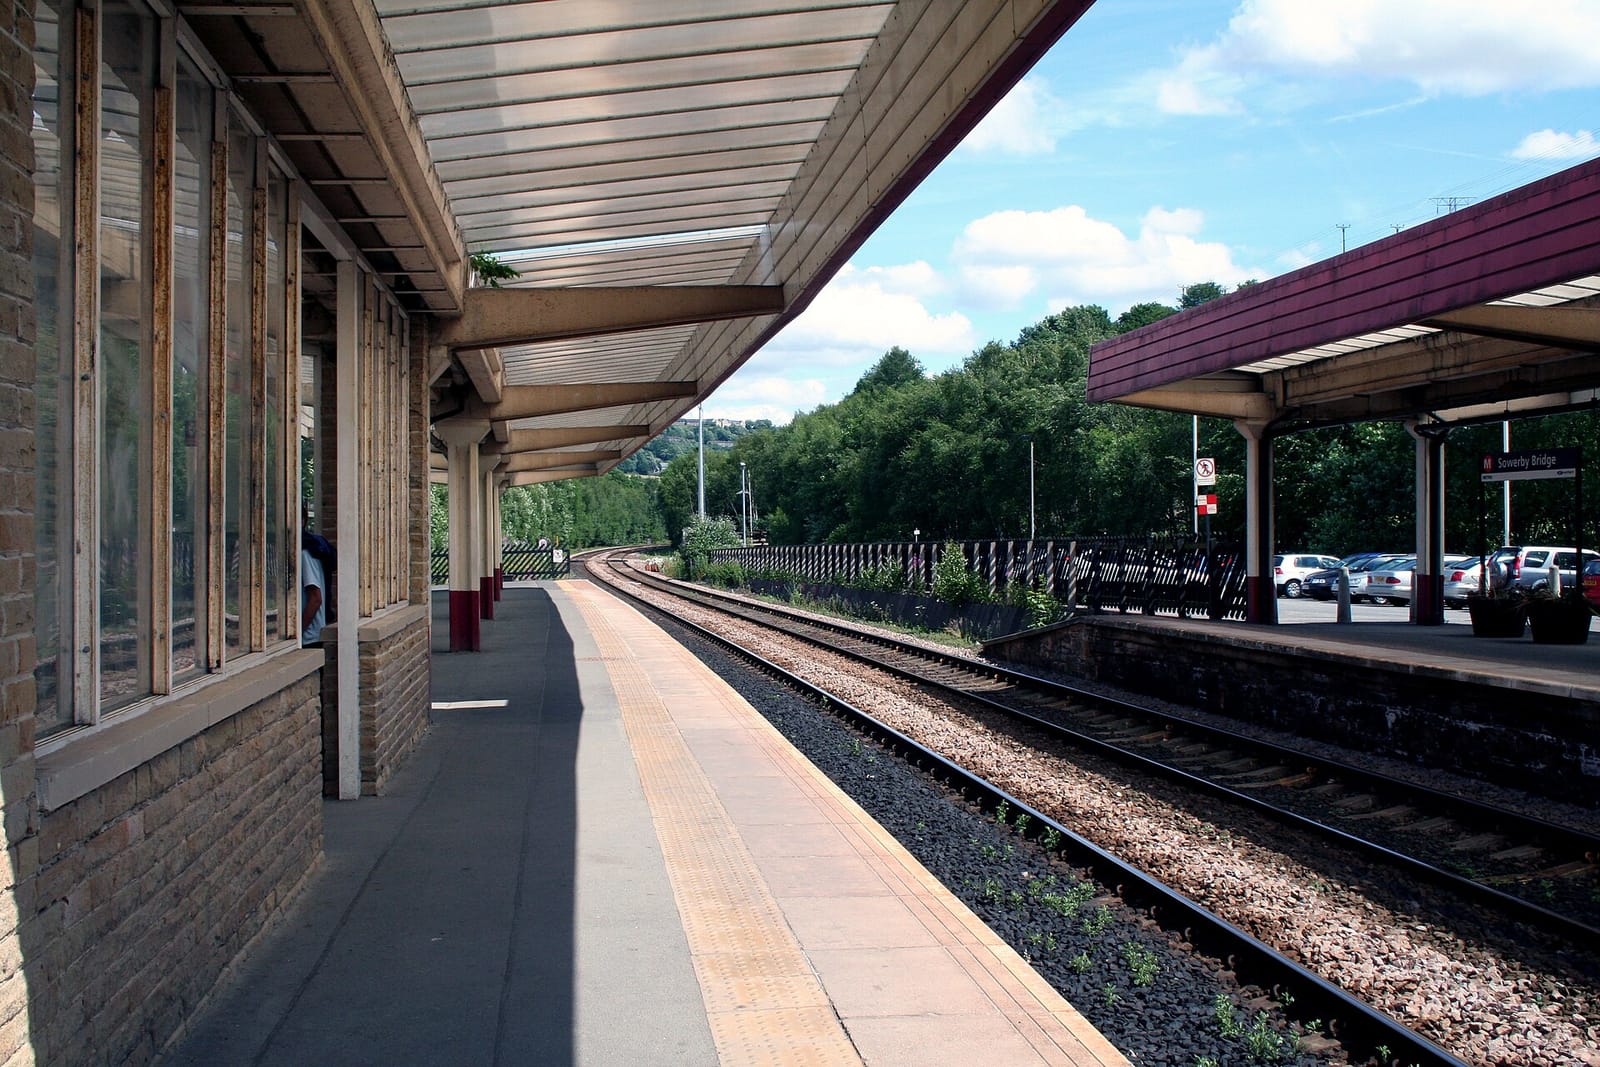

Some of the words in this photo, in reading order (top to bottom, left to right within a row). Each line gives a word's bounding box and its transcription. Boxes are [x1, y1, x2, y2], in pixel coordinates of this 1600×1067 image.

[1483, 458, 1492, 469] M
[1497, 455, 1529, 469] Sowerby
[1531, 454, 1557, 468] Bridge
